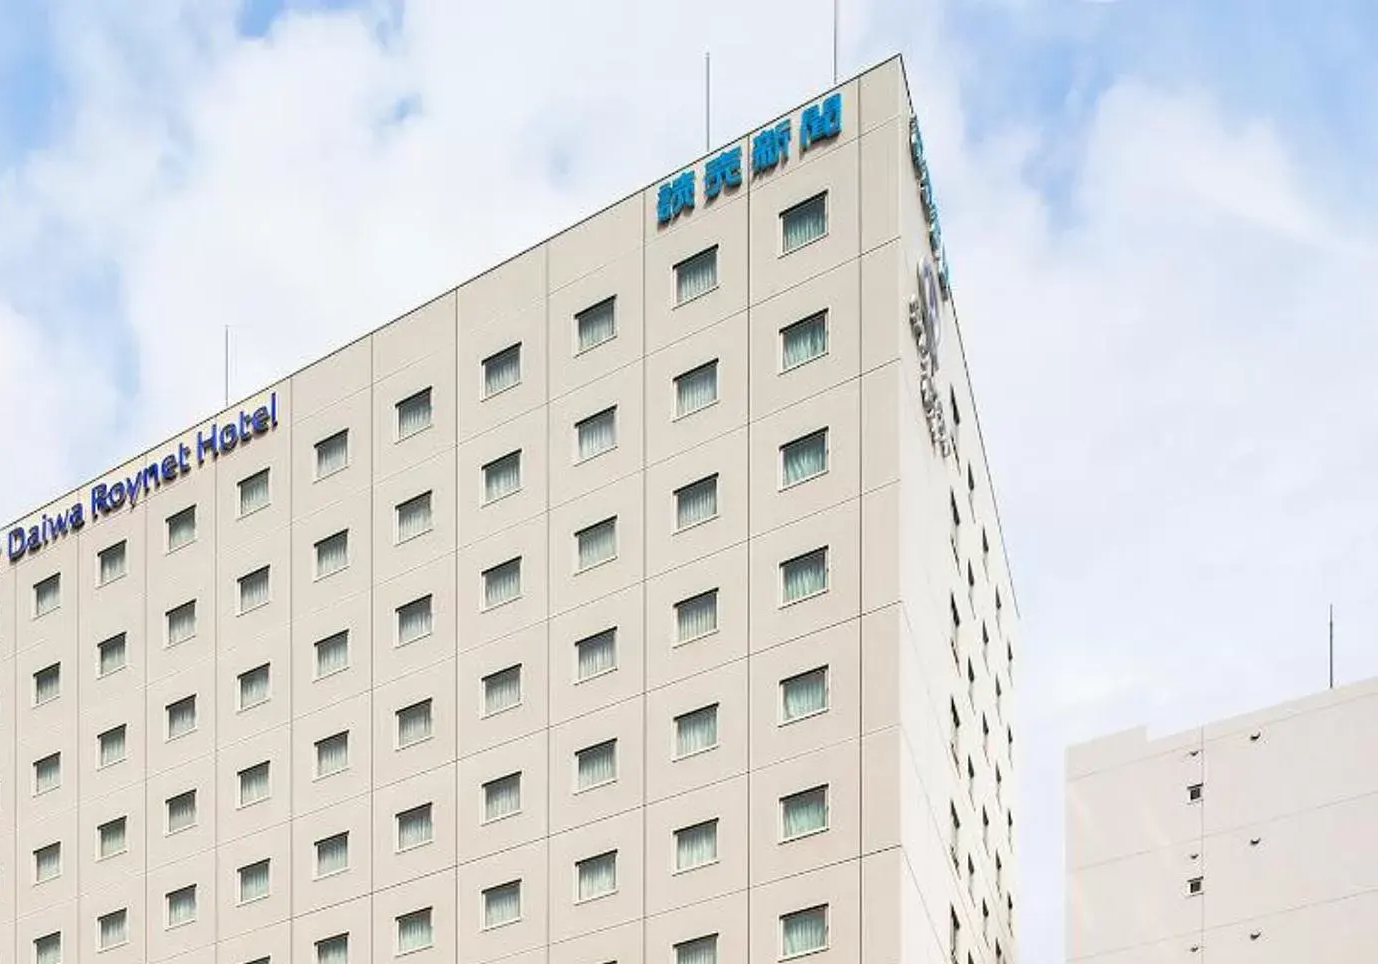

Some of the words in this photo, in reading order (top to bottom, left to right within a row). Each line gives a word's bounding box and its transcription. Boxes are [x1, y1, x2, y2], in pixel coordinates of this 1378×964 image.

[6, 500, 85, 561] Daiwa
[90, 442, 191, 516] Roynet
[196, 392, 279, 466] Hotel
